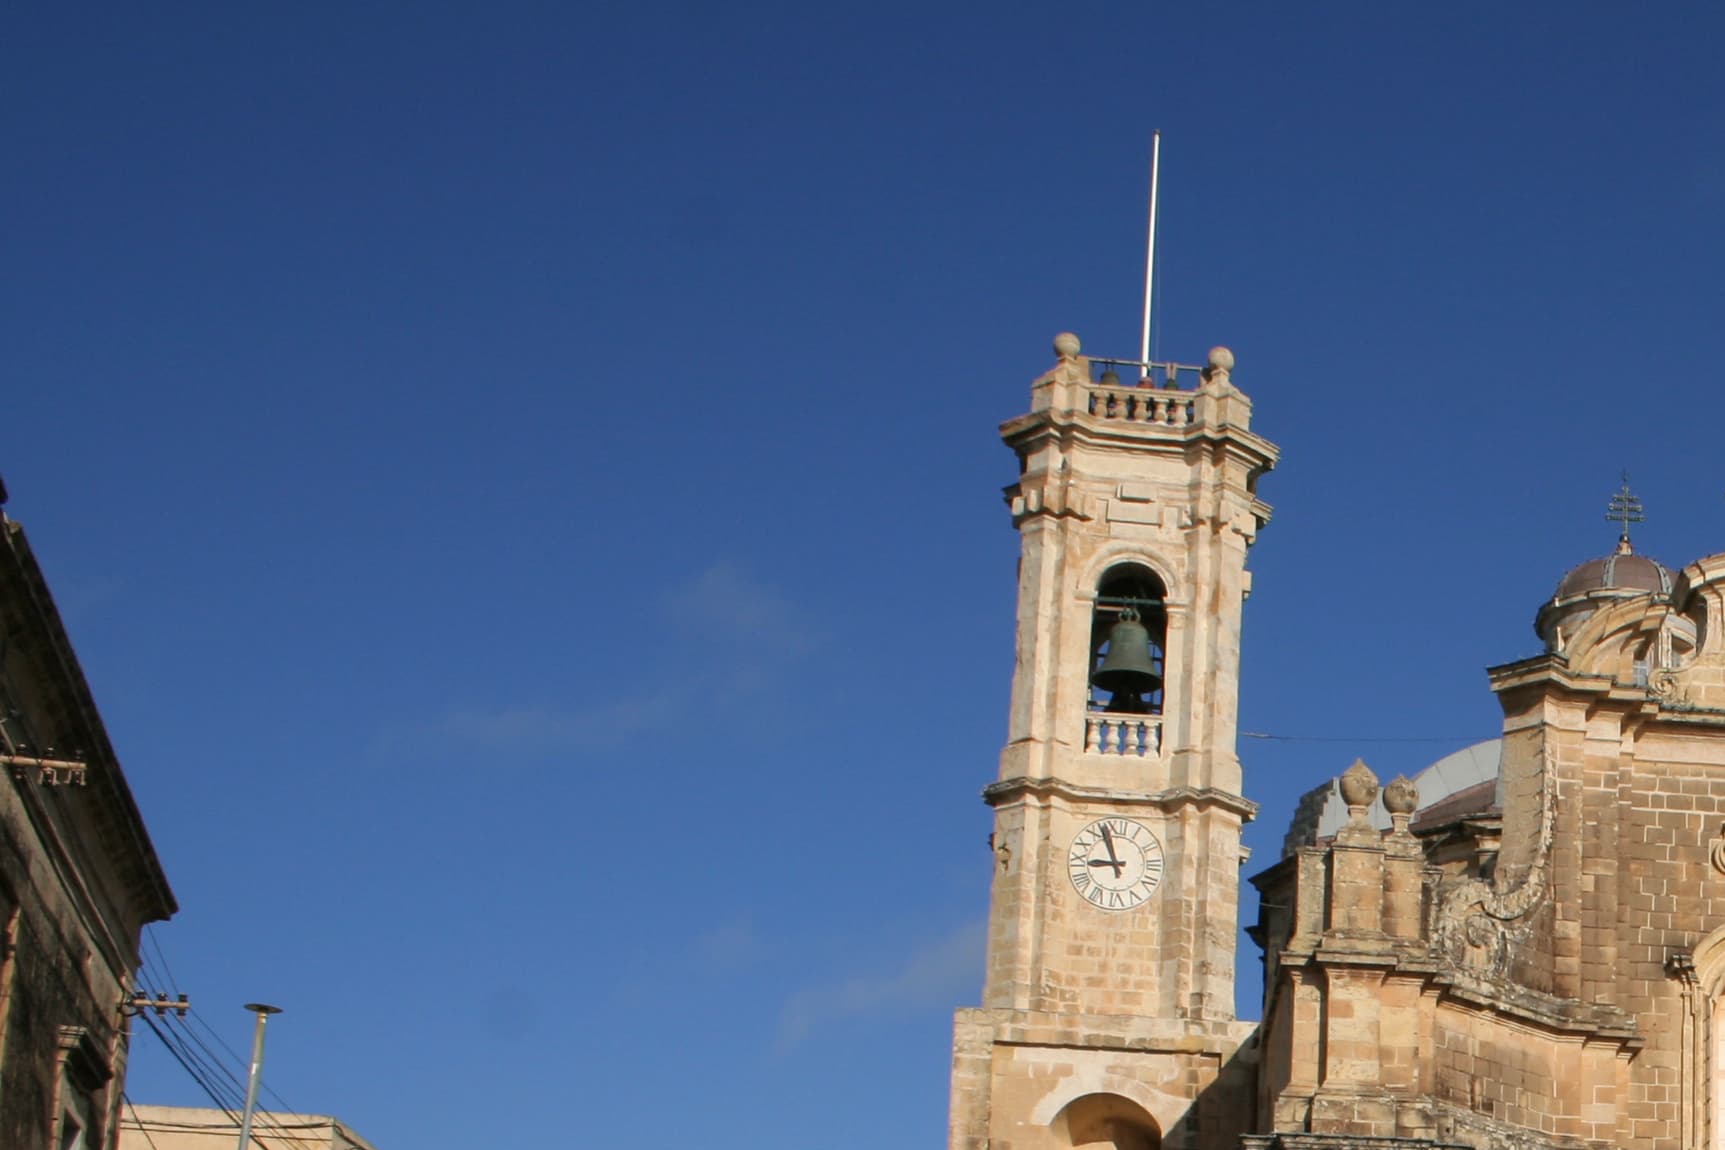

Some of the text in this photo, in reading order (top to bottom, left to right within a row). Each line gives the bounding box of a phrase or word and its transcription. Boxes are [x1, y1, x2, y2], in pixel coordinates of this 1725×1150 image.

[1074, 837, 1092, 852] X
[1141, 841, 1158, 853] II
[1070, 851, 1087, 867] IX
[1145, 859, 1161, 872] III
[1109, 891, 1125, 907] VI
